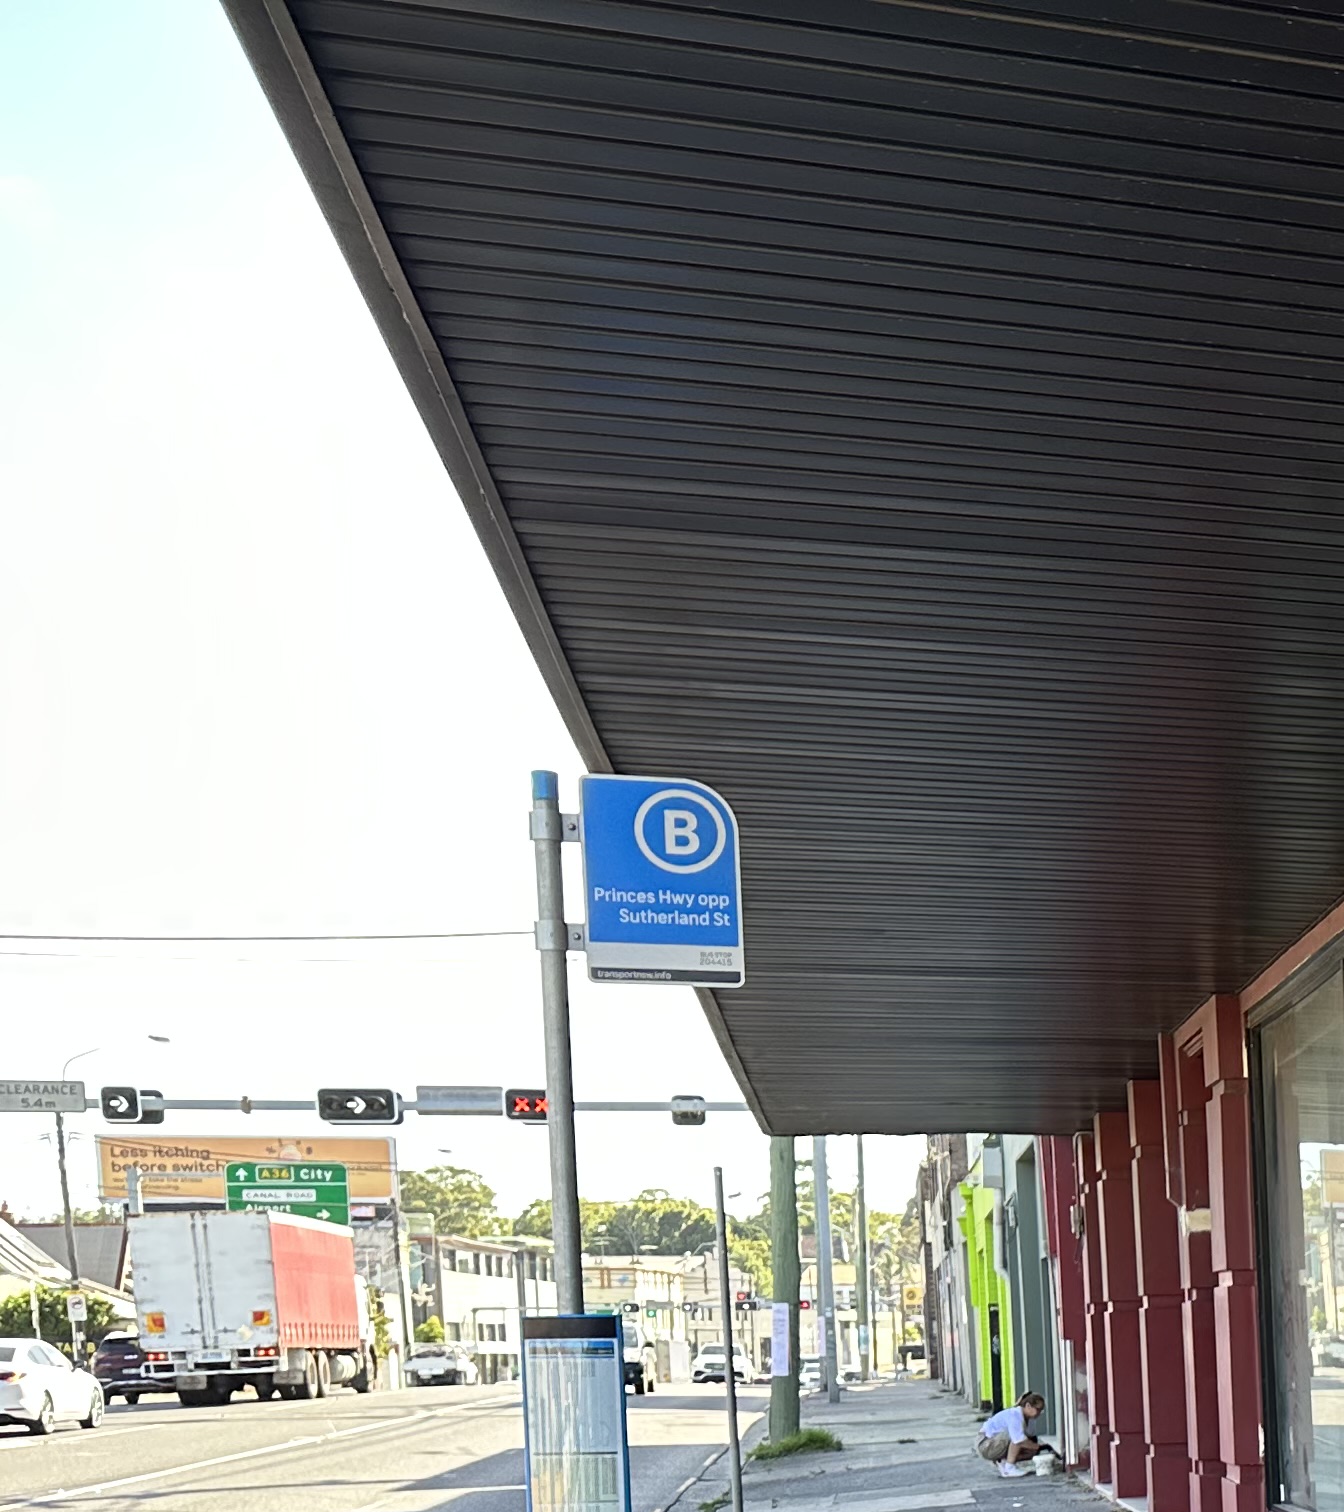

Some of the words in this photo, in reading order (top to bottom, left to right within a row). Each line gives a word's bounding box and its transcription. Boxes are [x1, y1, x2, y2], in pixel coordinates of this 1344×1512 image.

[663, 809, 701, 855] B
[594, 887, 656, 904] Princes
[658, 889, 696, 908] Hwy
[697, 894, 730, 909] opp
[619, 907, 710, 926] Sutherland
[713, 912, 731, 927] St
[0, 1084, 78, 1096] CLEARANCE
[110, 1145, 148, 1158] Less
[153, 1145, 210, 1160] itching
[261, 1168, 289, 1179] A36
[299, 1168, 333, 1182] City
[245, 1191, 281, 1199] CANAL
[286, 1191, 314, 1199] ROAD
